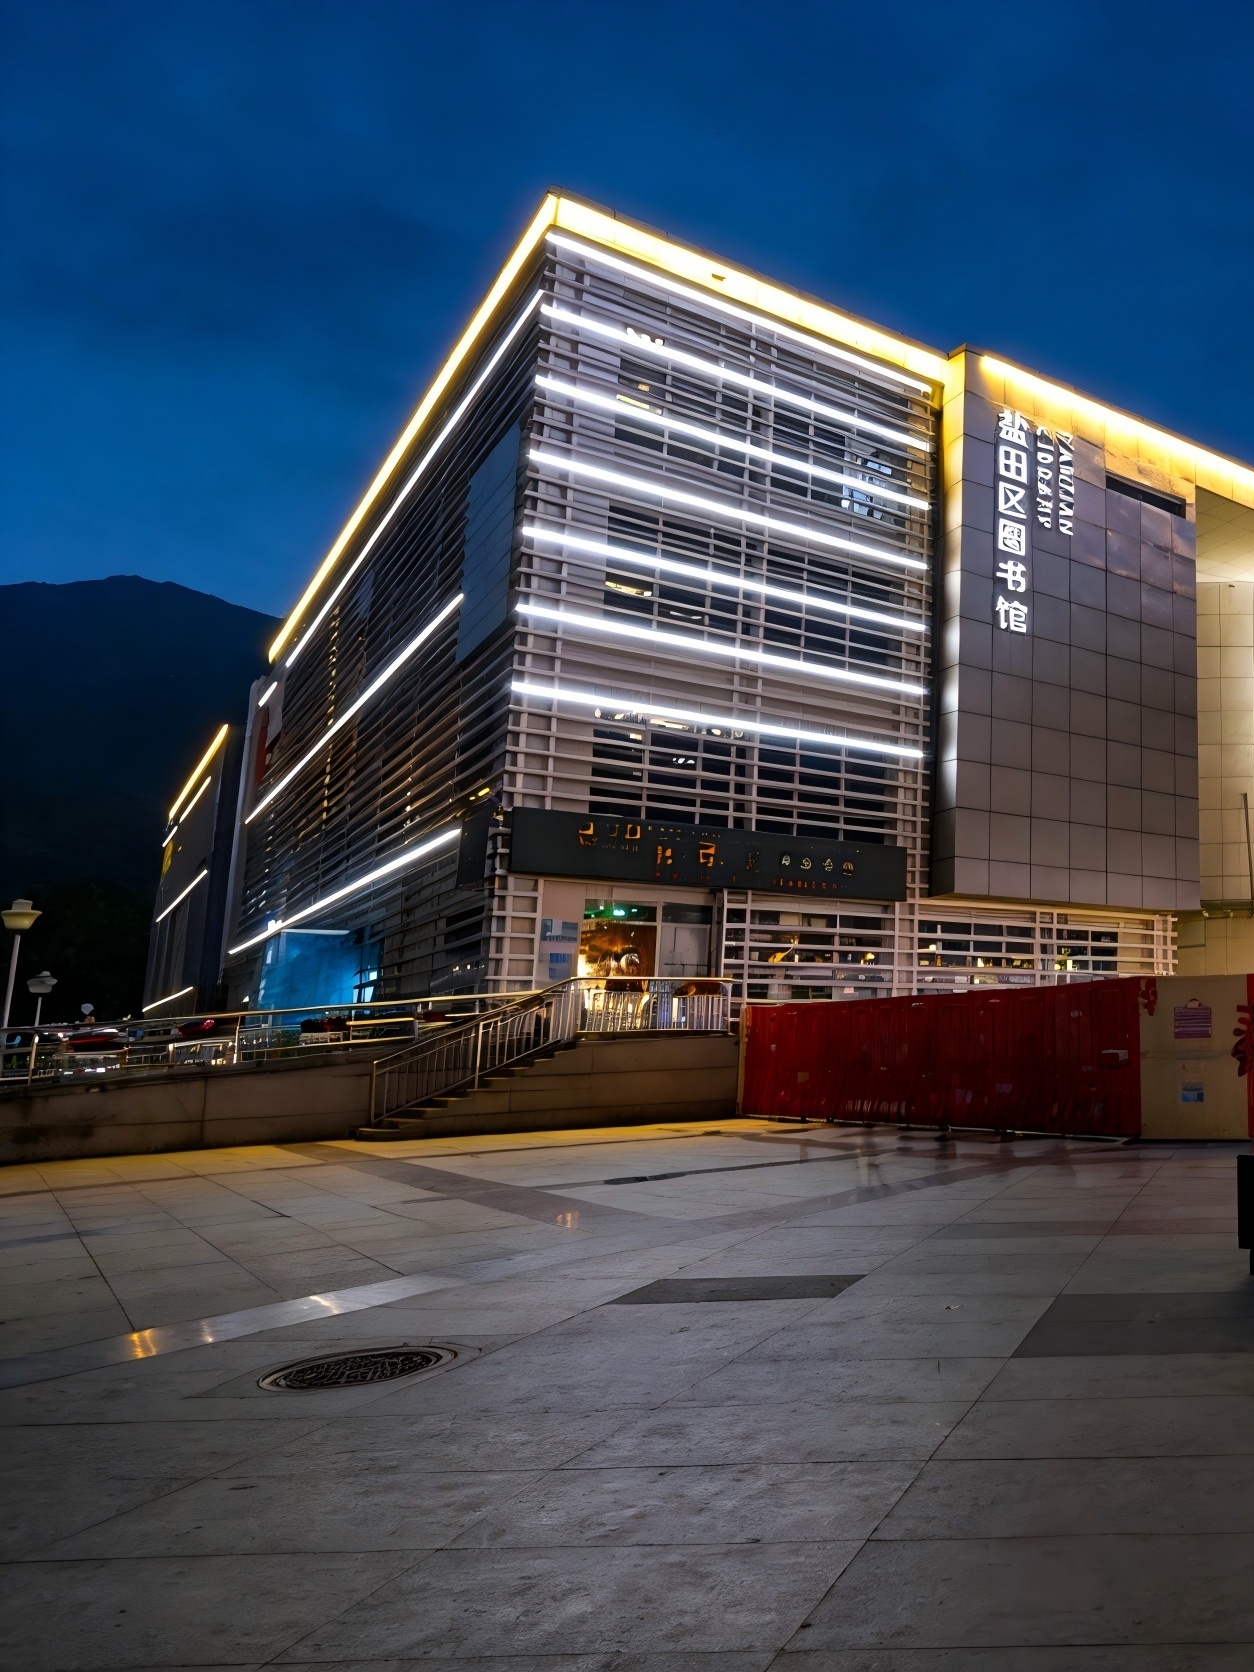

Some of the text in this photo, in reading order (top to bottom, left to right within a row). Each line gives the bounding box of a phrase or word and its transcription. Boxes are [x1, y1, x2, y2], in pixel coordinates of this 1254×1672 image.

[996, 408, 1030, 633] 盐田区图书馆
